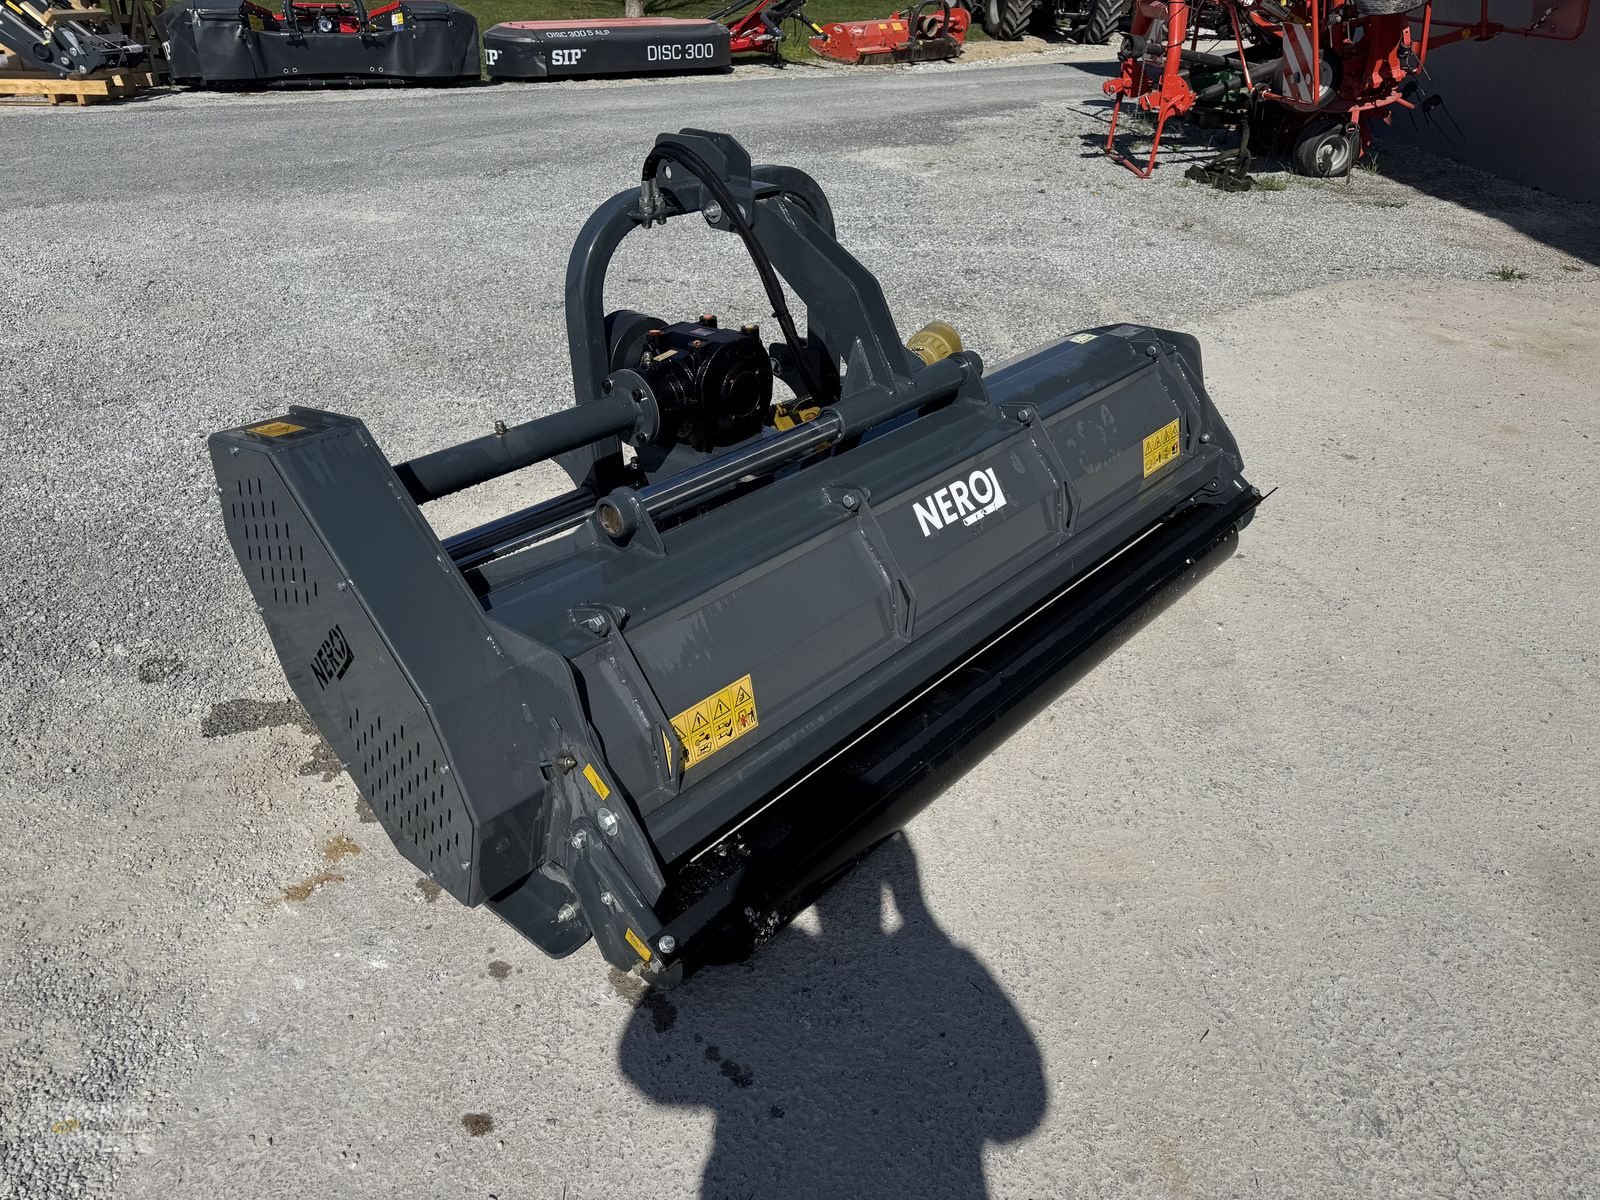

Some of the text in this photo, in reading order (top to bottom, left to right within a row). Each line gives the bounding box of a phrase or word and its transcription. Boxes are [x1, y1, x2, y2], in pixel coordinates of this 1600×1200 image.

[546, 31, 568, 39] DISC
[647, 43, 714, 61] DISC 300
[912, 469, 994, 538] NERO
[310, 627, 347, 691] NERO
